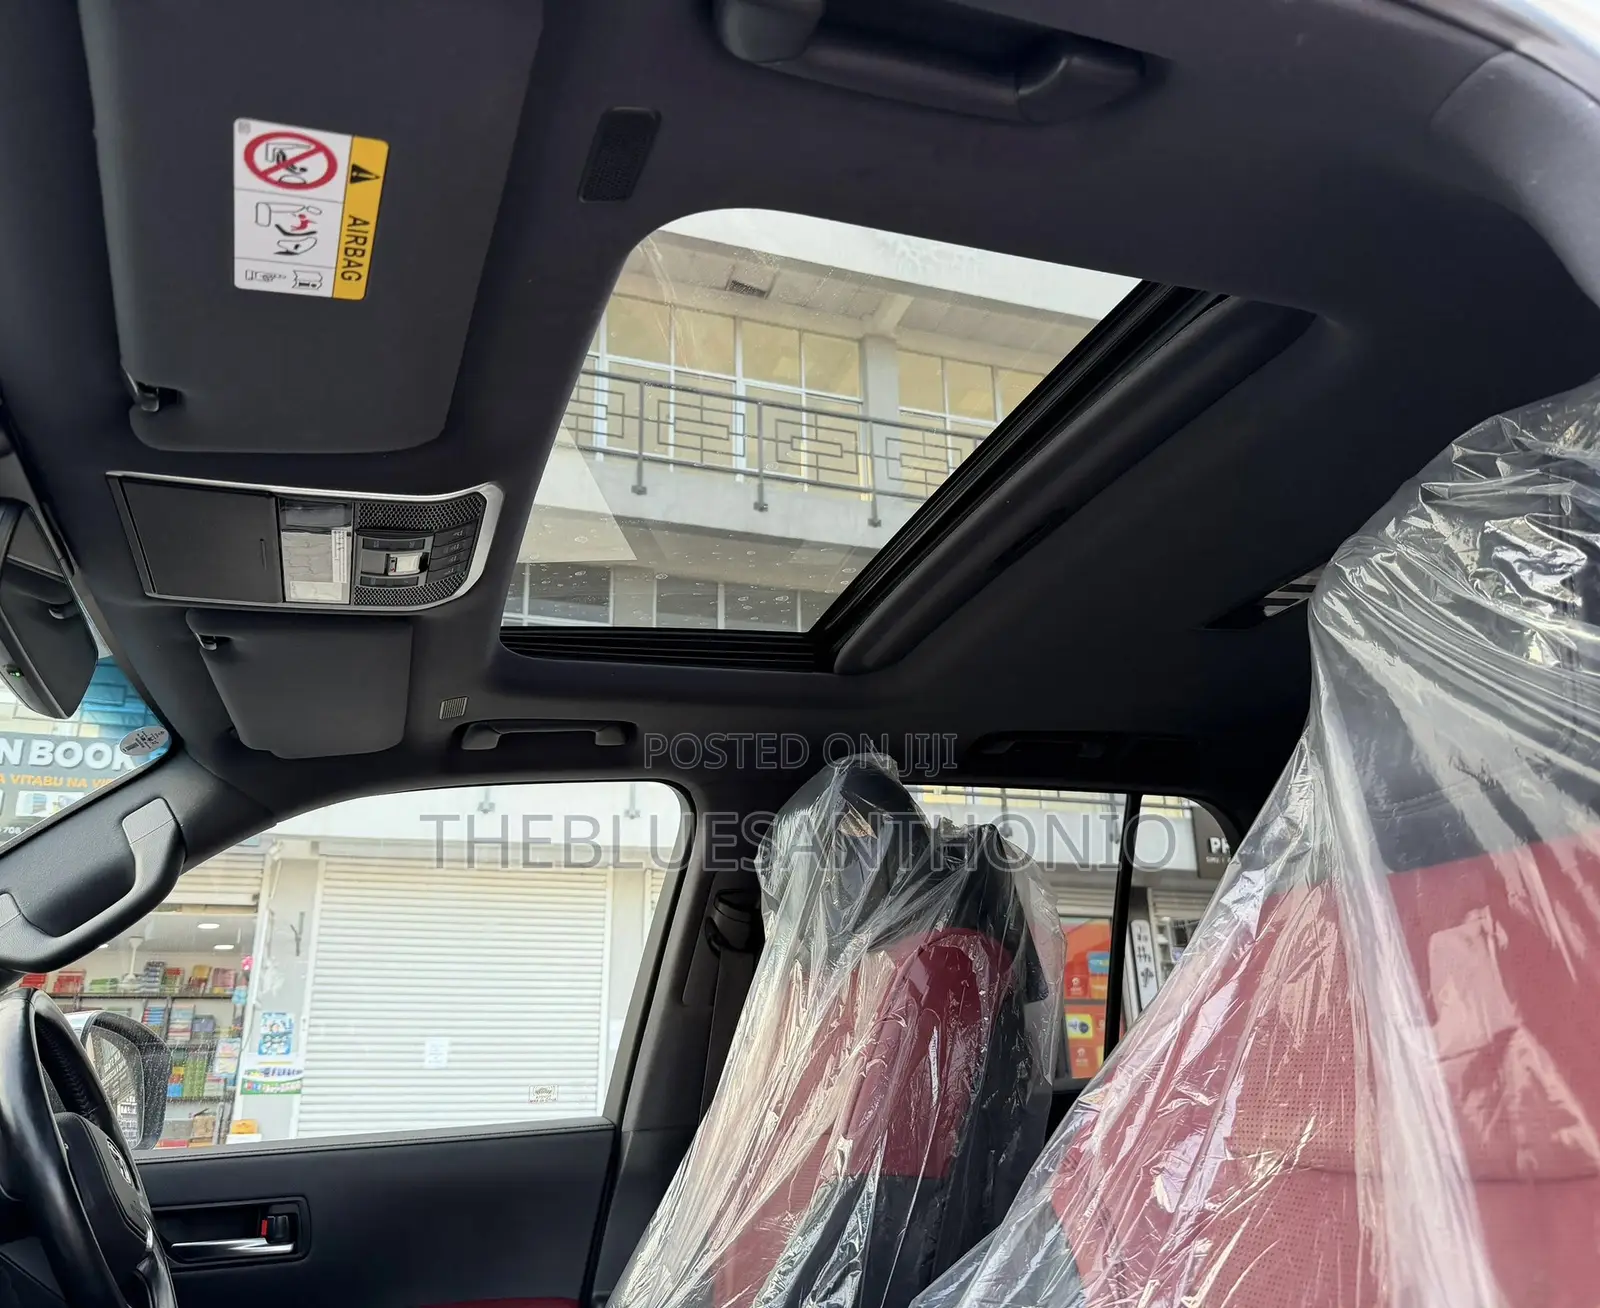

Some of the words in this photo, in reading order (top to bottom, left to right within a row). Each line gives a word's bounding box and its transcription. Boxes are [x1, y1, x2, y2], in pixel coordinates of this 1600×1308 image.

[341, 215, 370, 282] AIRBAG
[10, 774, 63, 787] VITABU
[67, 777, 88, 788] NA
